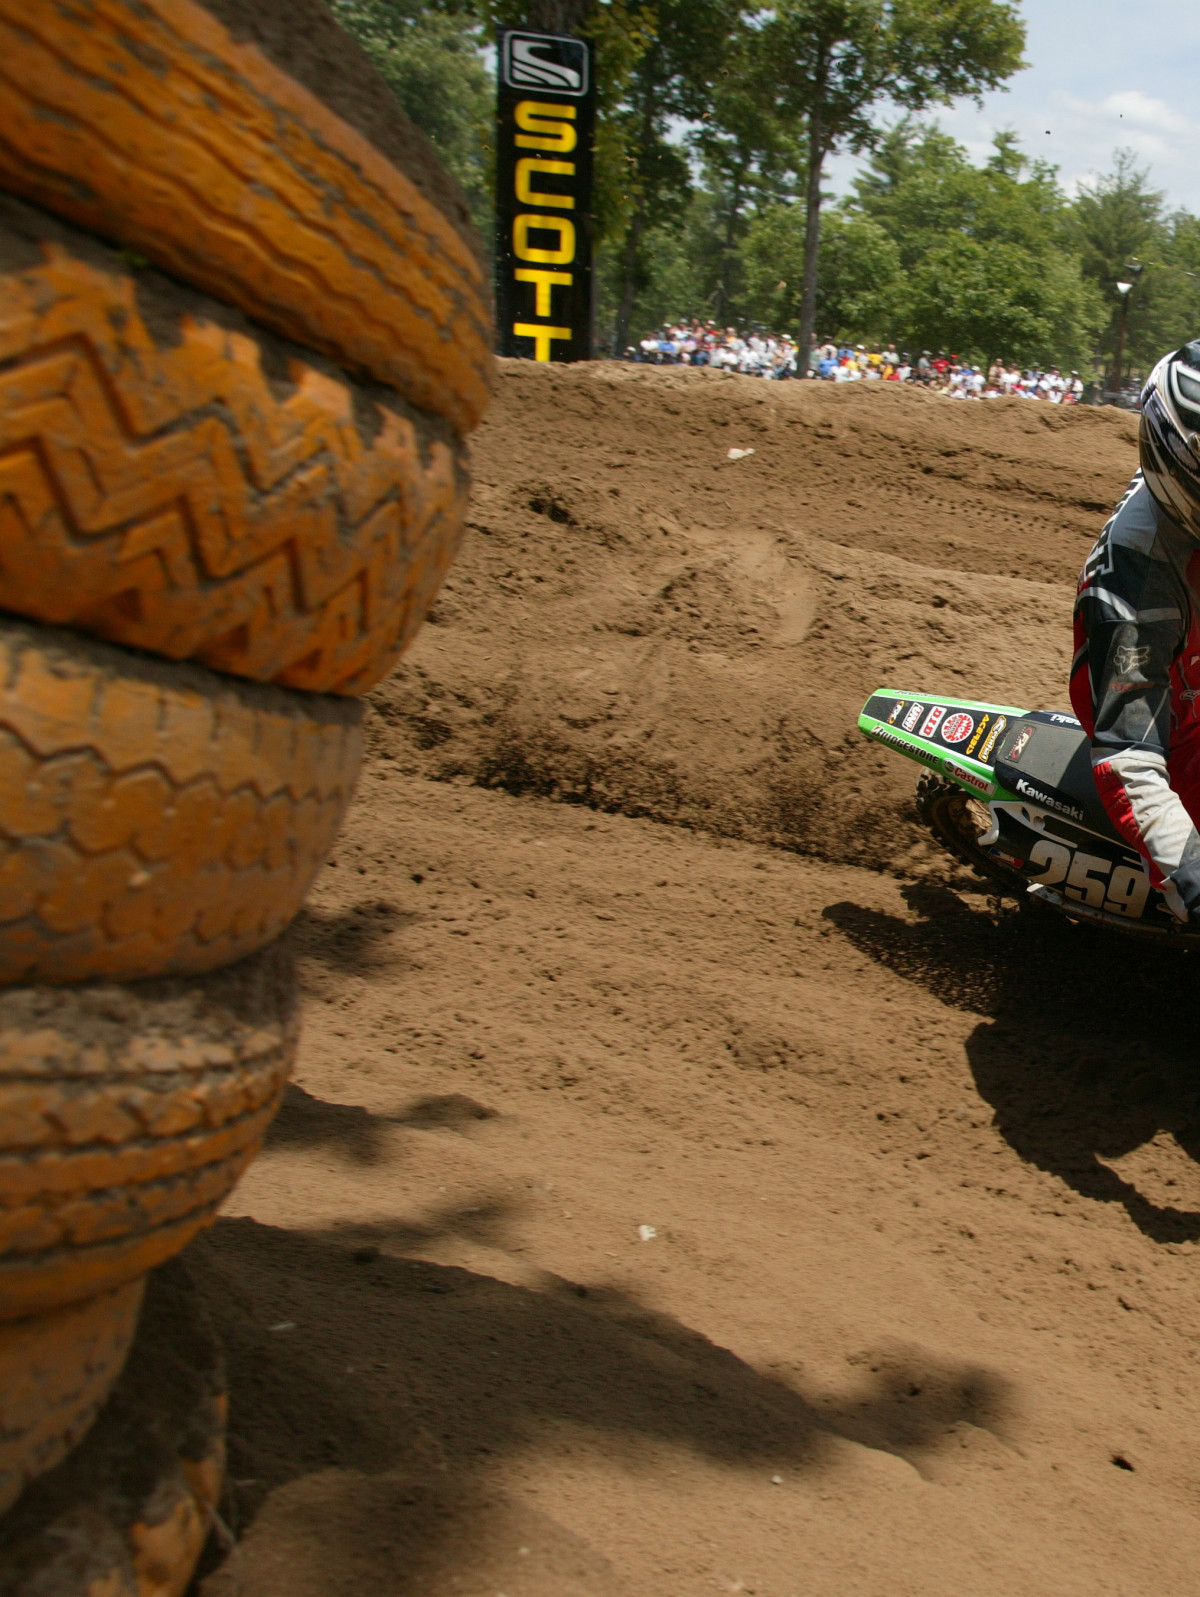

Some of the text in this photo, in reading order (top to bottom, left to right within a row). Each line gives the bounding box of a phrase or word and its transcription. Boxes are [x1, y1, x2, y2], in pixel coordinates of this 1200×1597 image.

[513, 100, 577, 361] SCOTT
[871, 726, 940, 764] BRIDGESTONE
[953, 719, 969, 739] NGK
[966, 714, 990, 755] ACERBIS
[954, 767, 989, 791] Castrol
[1016, 779, 1084, 820] Kawasaki
[1028, 839, 1151, 918] 259
